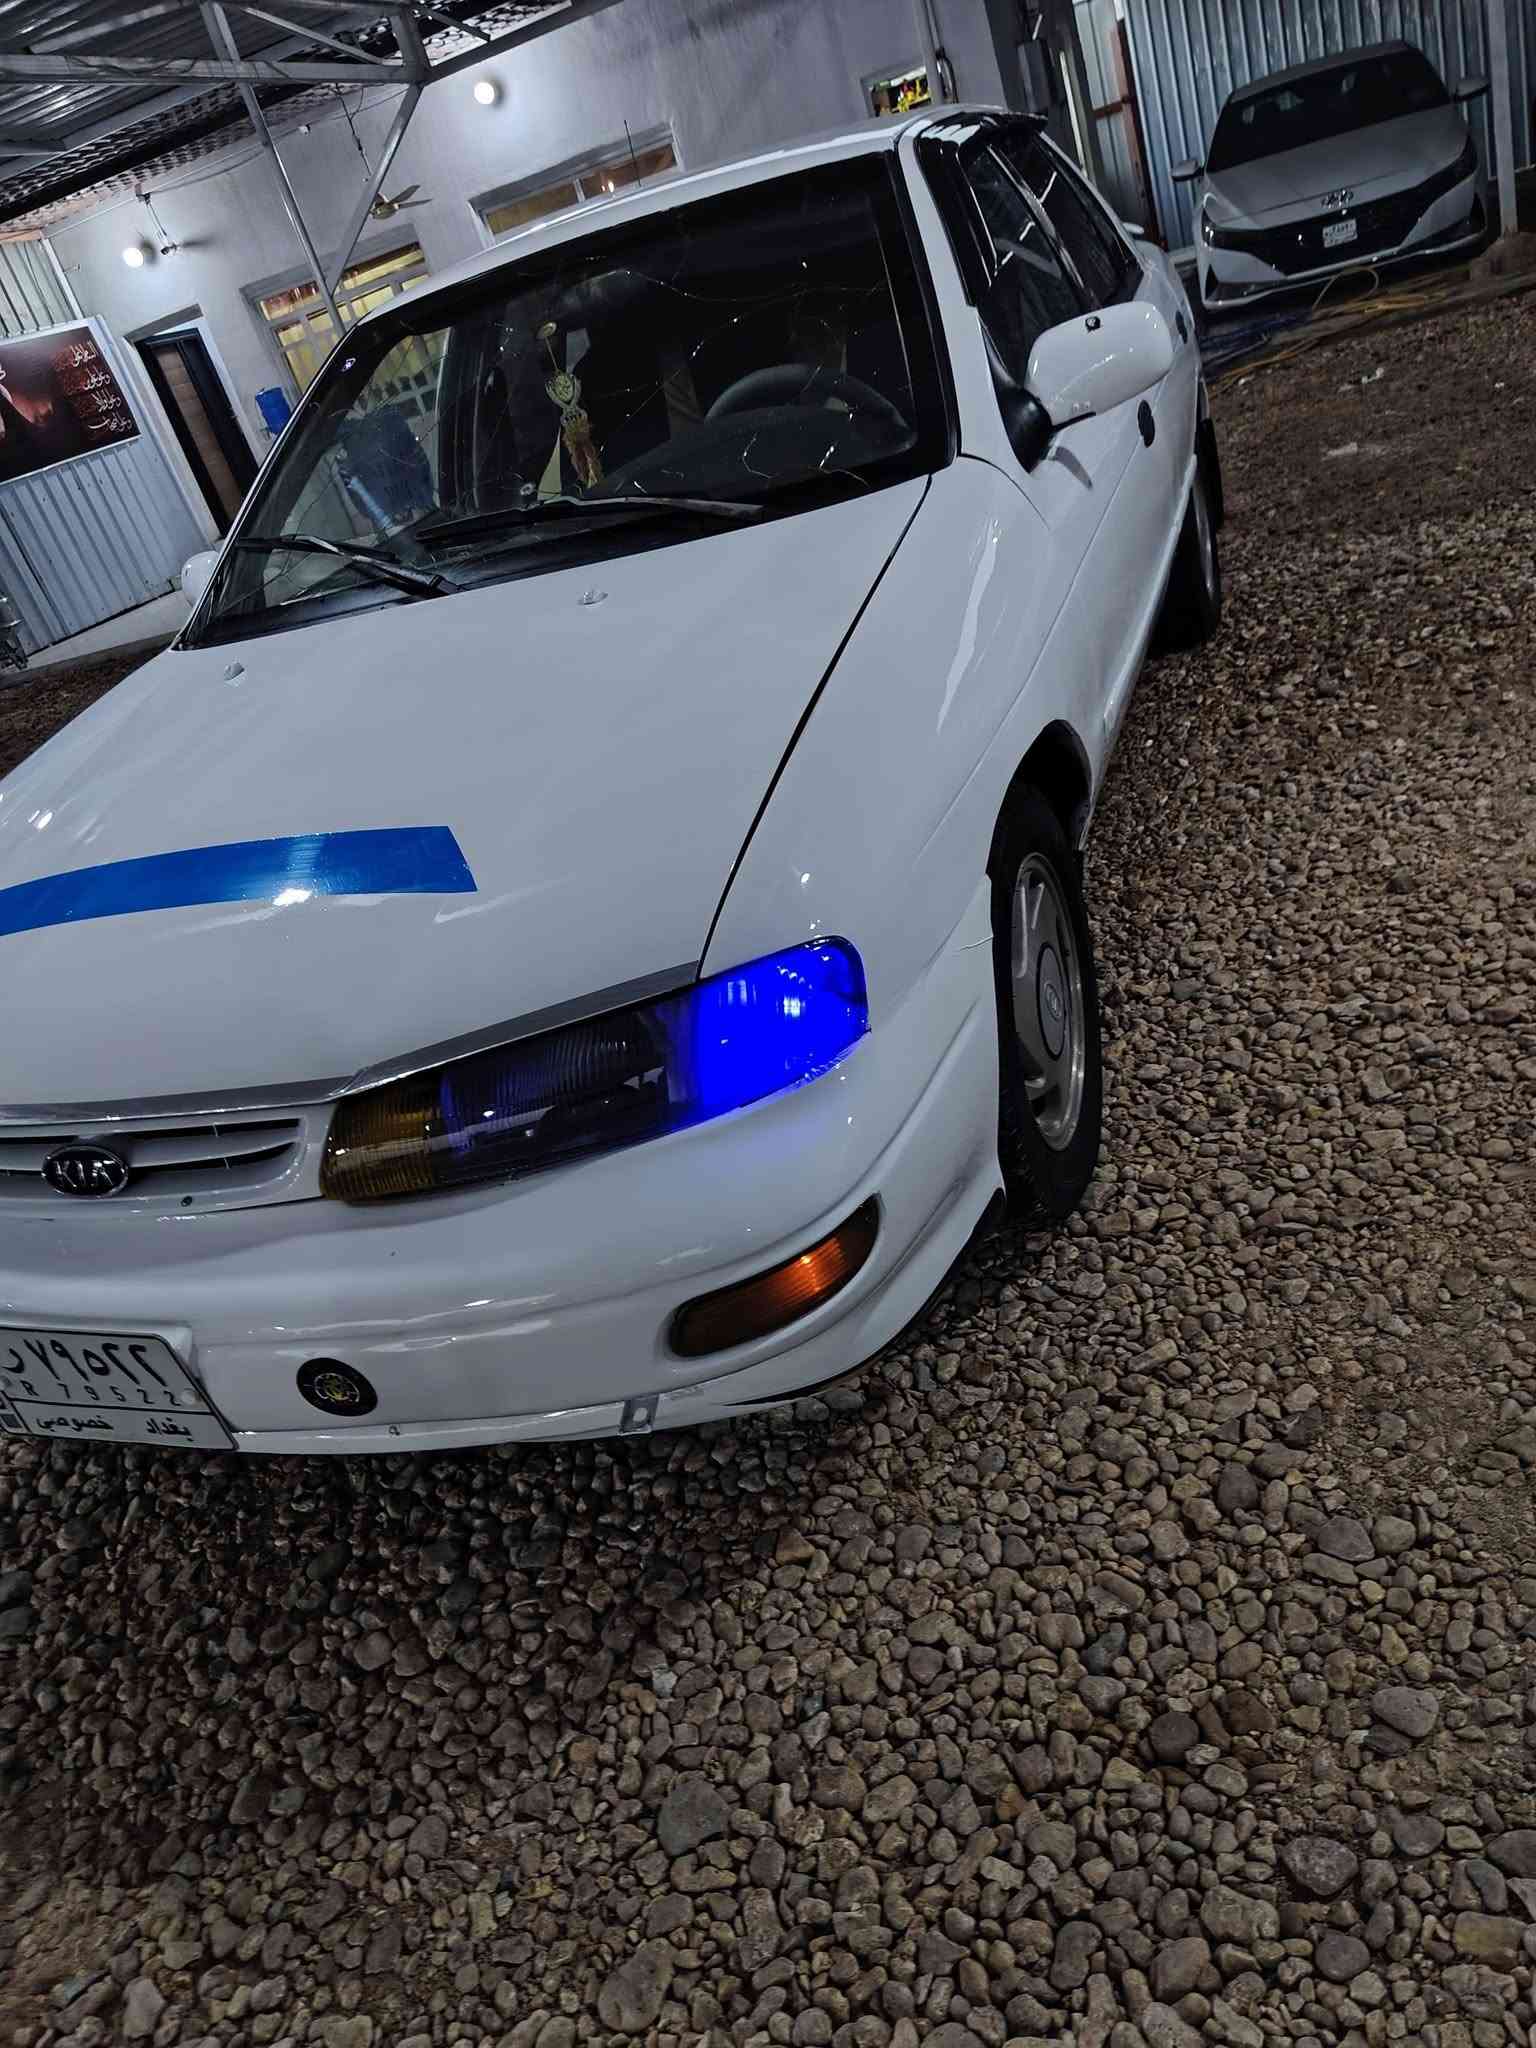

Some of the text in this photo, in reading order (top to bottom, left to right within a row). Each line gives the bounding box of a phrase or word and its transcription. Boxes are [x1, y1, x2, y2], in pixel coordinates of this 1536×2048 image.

[55, 1158, 115, 1188] KIA
[36, 1414, 195, 1442] بغداد خصوصي
